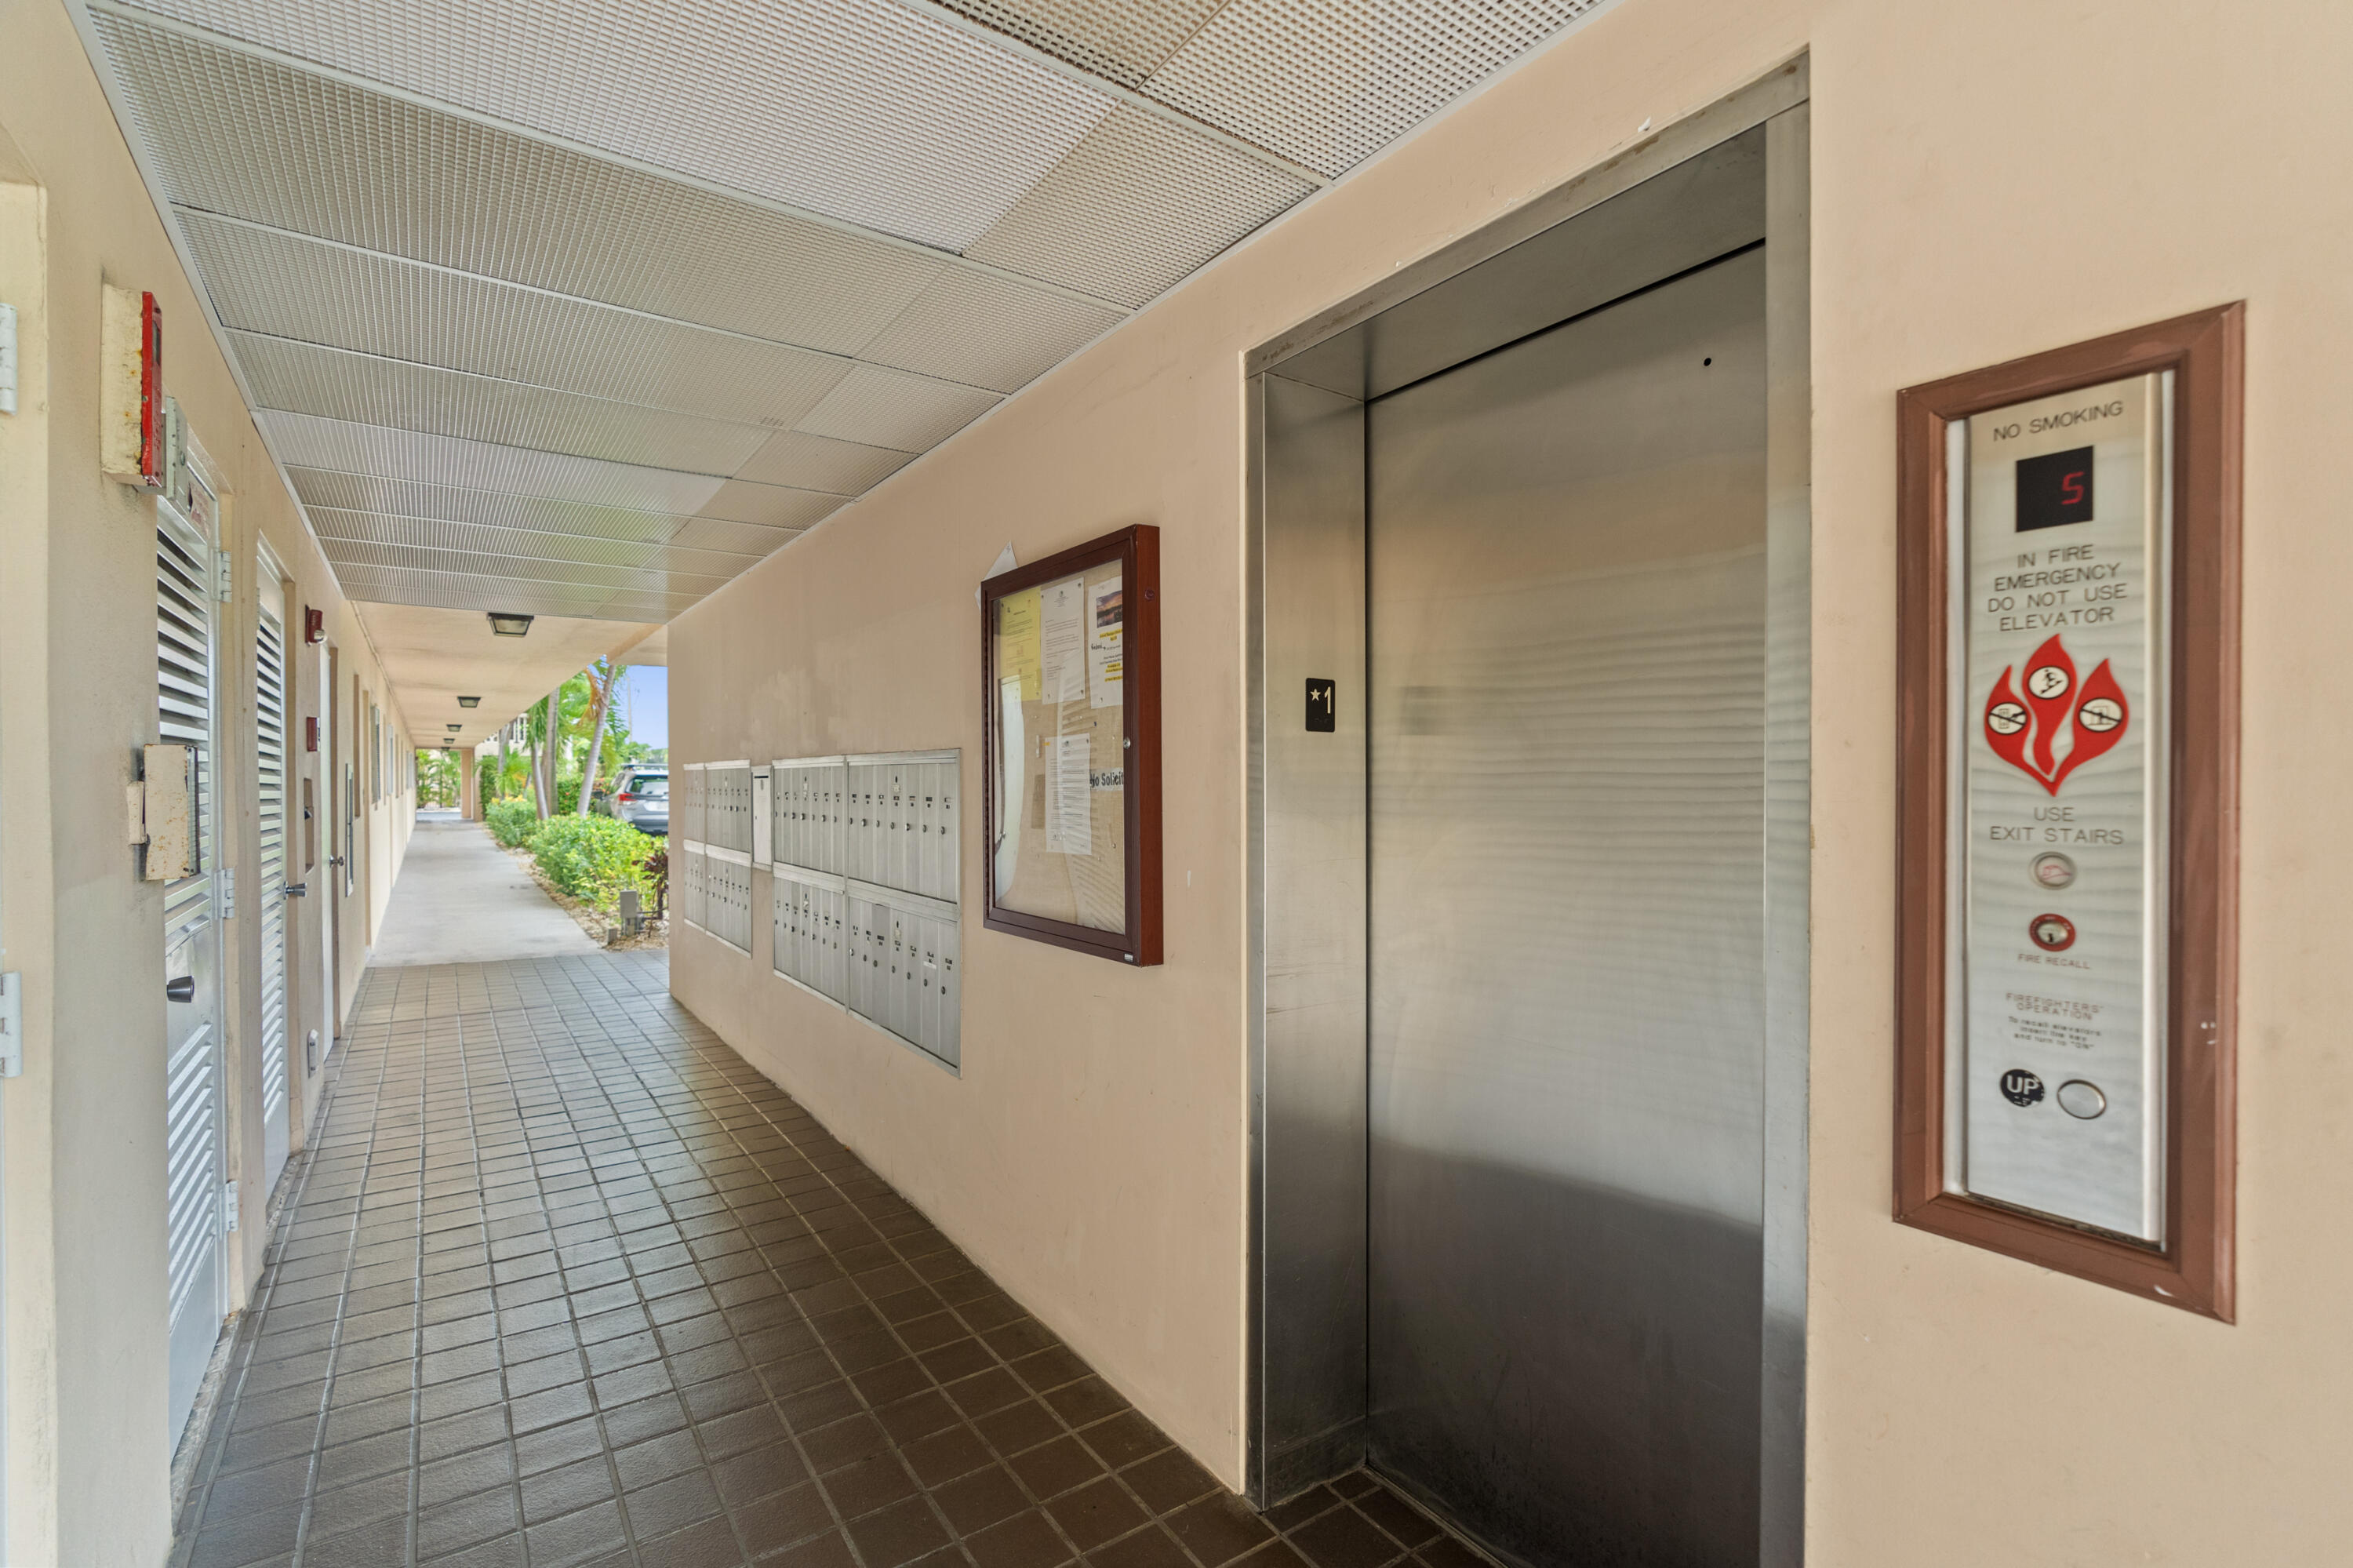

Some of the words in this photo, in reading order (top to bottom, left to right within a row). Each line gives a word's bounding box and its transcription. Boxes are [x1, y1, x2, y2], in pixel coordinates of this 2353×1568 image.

[1993, 424, 2021, 442] NO
[2029, 401, 2124, 433] SMOKING
[2017, 552, 2036, 568] IN
[2048, 544, 2093, 564] FIRE
[1995, 562, 2121, 591] EMERGENCY
[1988, 596, 2015, 613] DO
[2027, 590, 2070, 608] NOT
[2084, 583, 2127, 602] USE
[1999, 606, 2115, 631] ELEVATOR
[2034, 806, 2076, 822] USE
[1990, 826, 2035, 841] EXIT
[2044, 828, 2124, 845] STAIRS
[2017, 953, 2041, 964] FIRE
[2045, 956, 2091, 970] RECALL
[2016, 1002, 2093, 1020] OPERATION
[2006, 1075, 2040, 1095] UP
